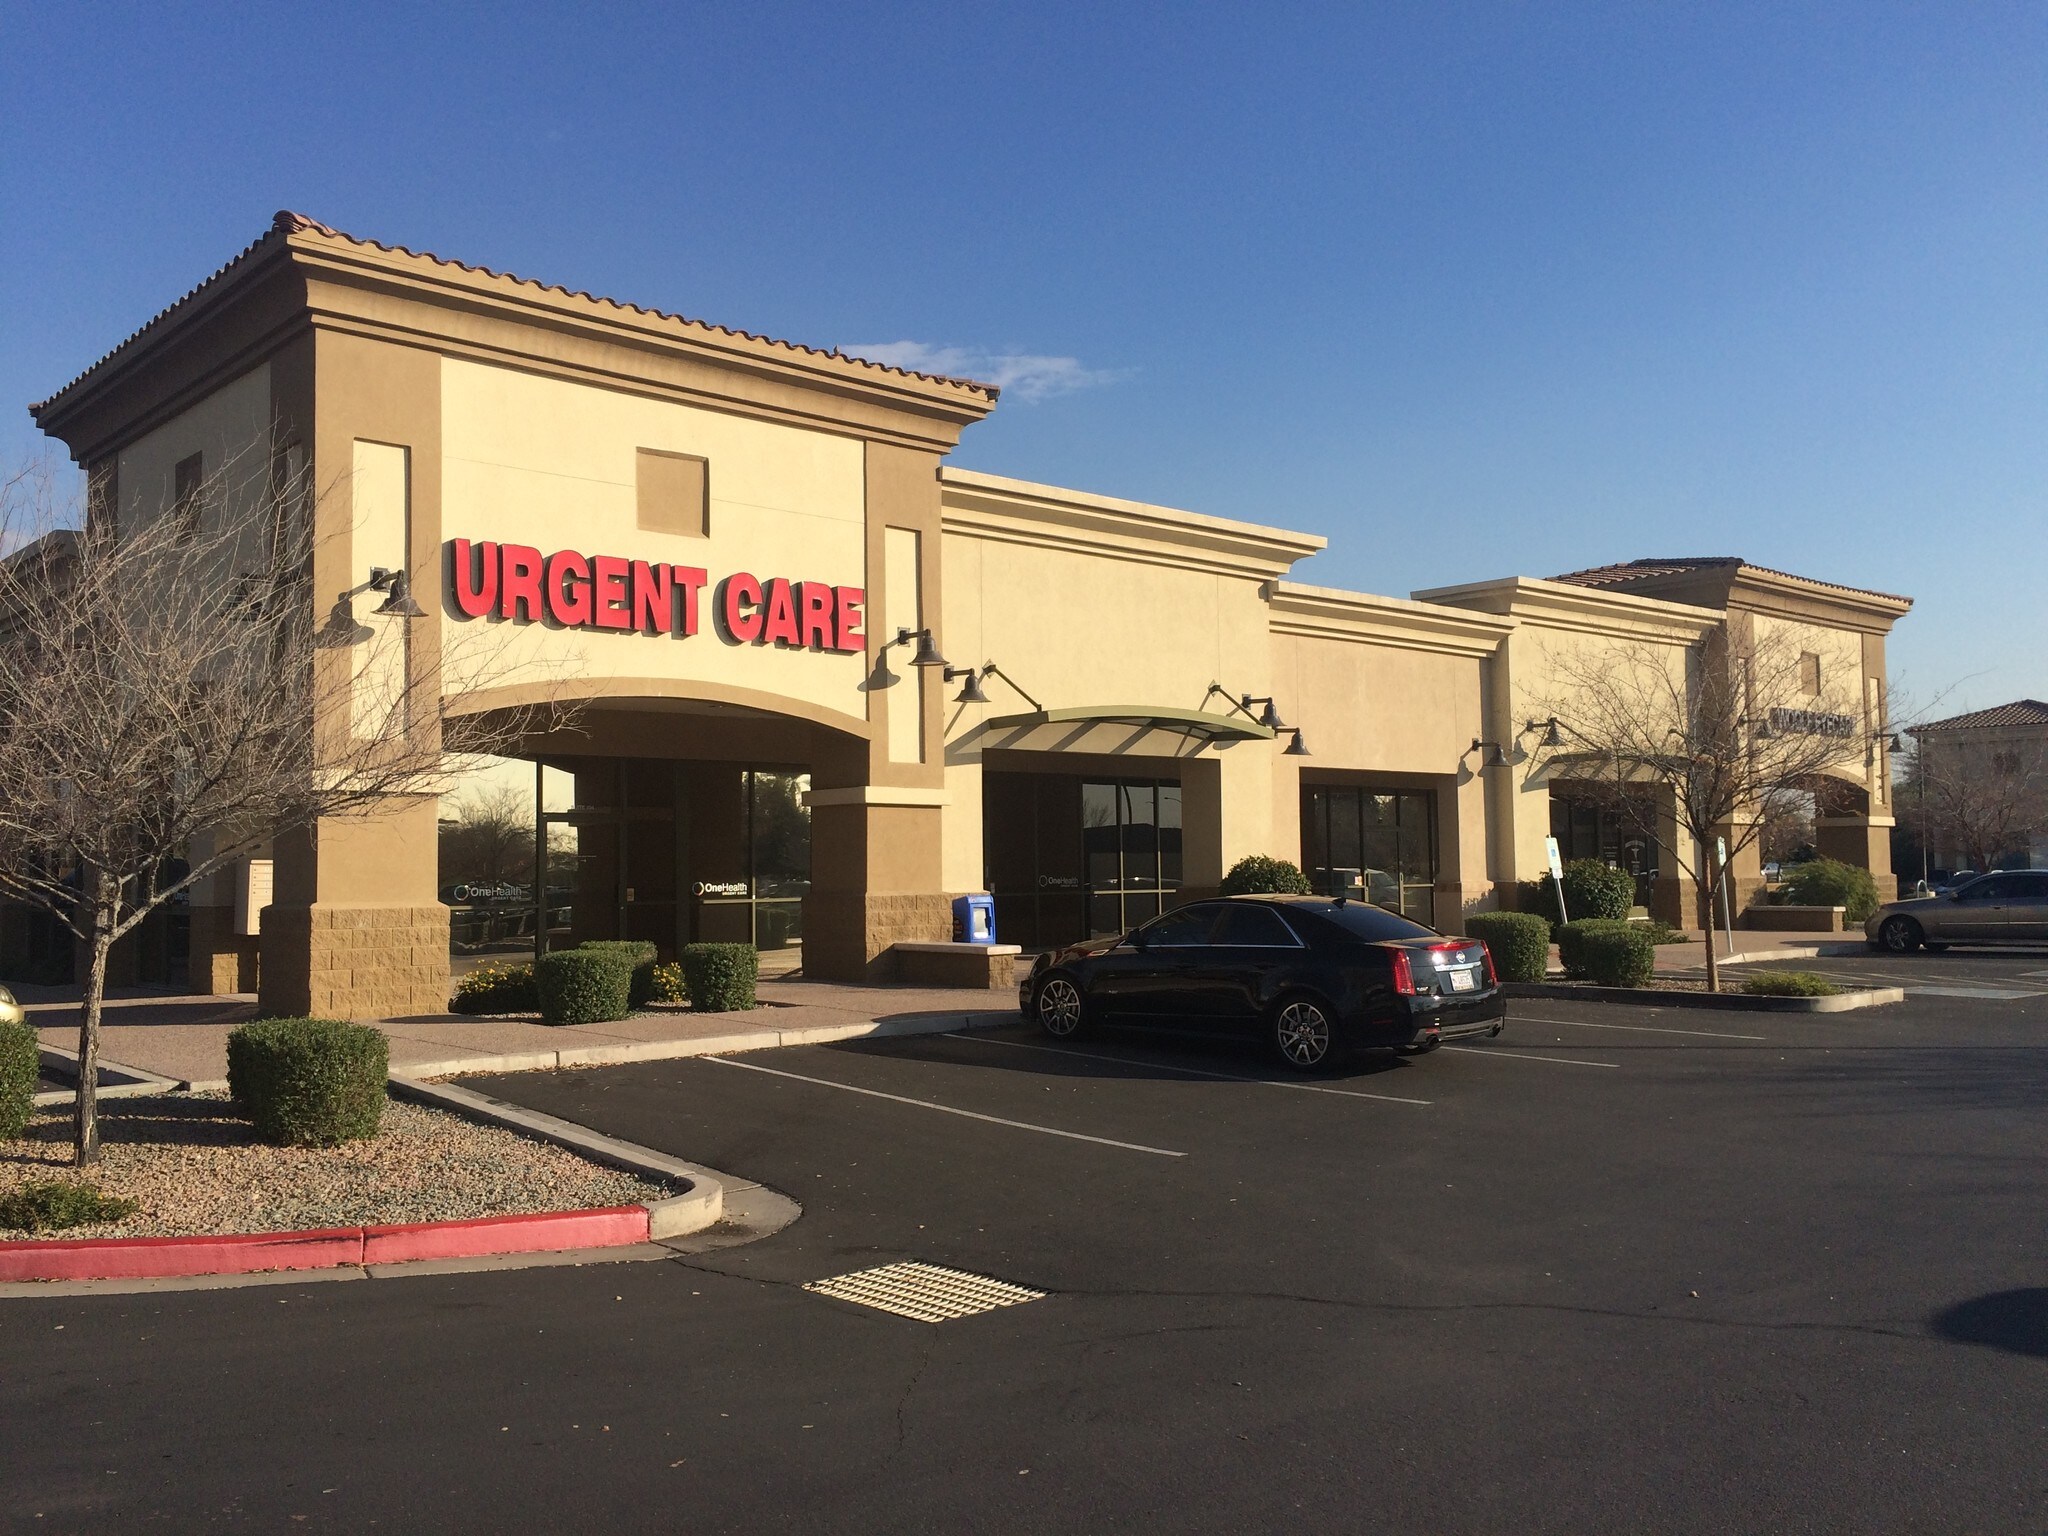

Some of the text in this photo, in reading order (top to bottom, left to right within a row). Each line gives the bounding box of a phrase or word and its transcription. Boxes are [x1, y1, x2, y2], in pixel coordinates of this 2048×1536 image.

[447, 538, 866, 654] URGENT CARE
[1048, 876, 1079, 885] OneHealth
[470, 886, 522, 897] OneHealth
[705, 883, 747, 892] OneHealth
